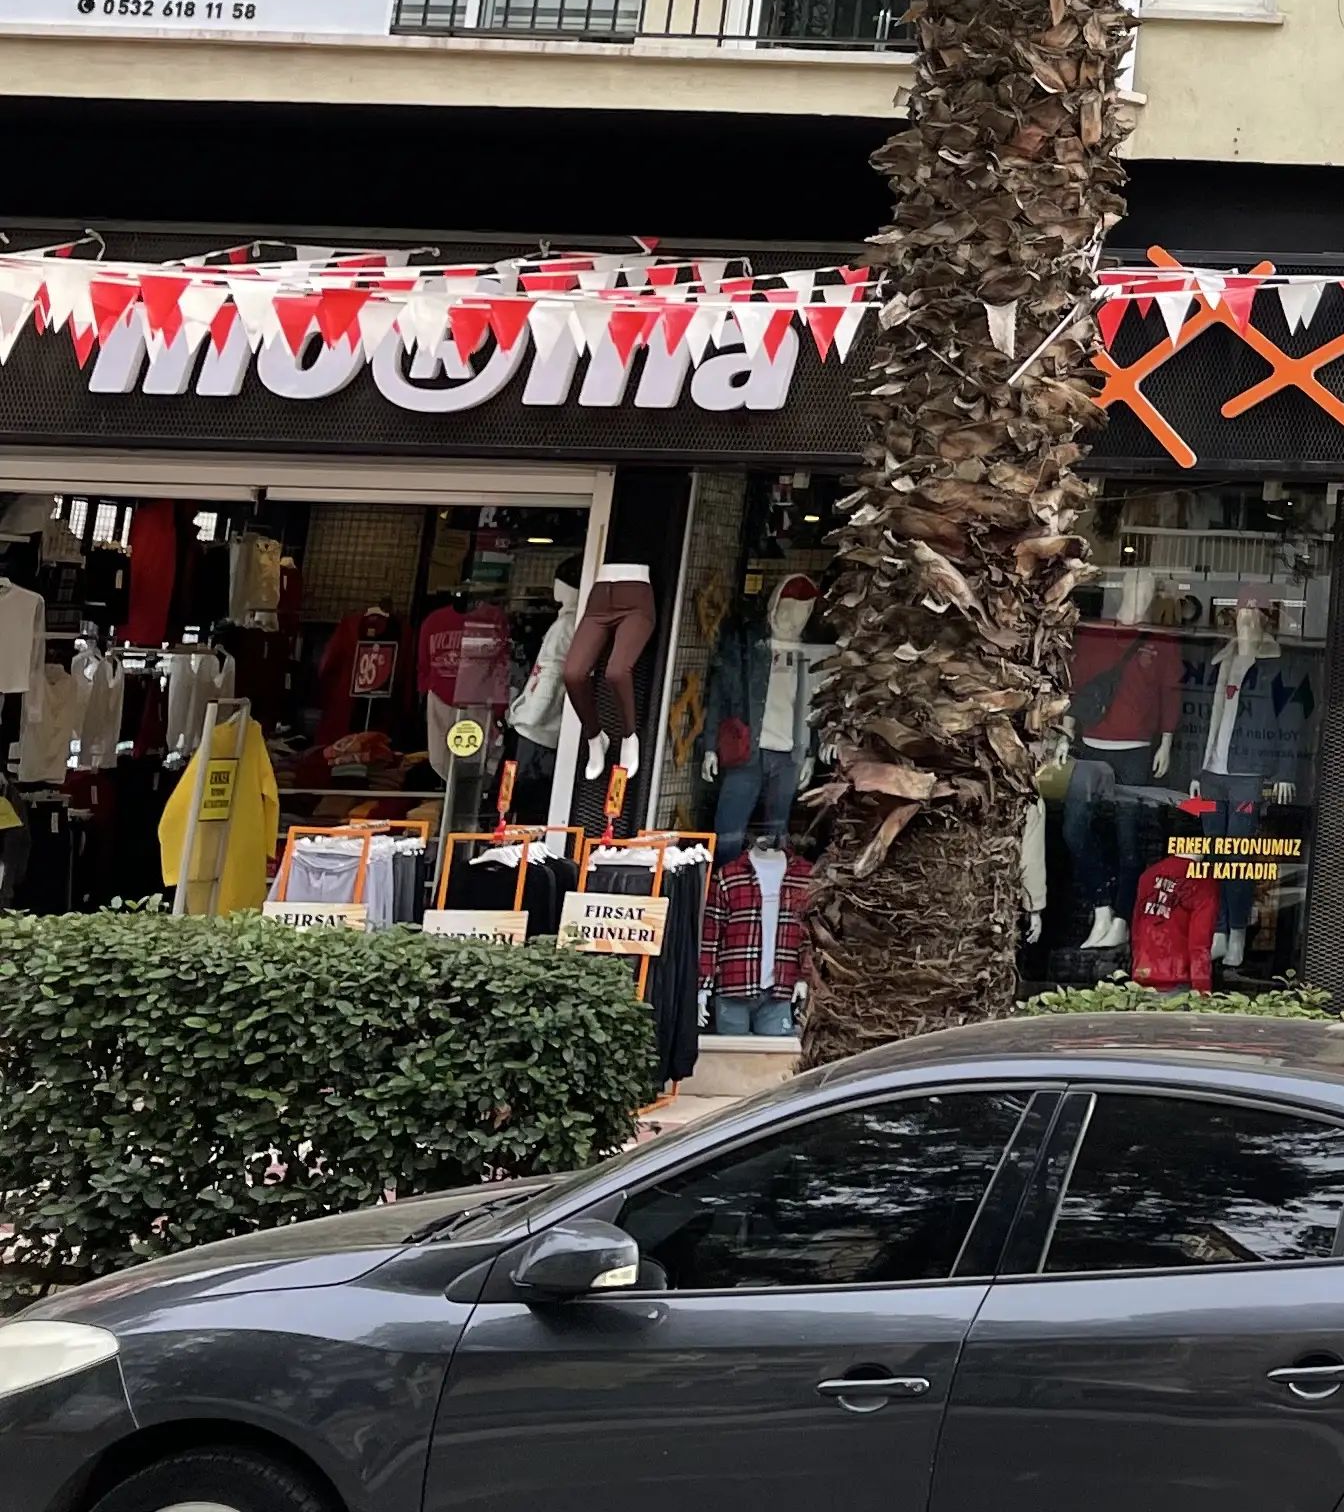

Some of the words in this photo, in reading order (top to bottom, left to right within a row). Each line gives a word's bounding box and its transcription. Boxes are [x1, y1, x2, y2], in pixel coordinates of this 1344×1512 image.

[103, 0, 154, 17] 0532
[163, 1, 195, 18] 618
[206, 2, 222, 19] 11
[232, 3, 256, 20] 58
[1167, 836, 1212, 855] ERKEK
[1214, 837, 1302, 857] REYONUMUZ
[1186, 861, 1211, 880] ALT
[1213, 862, 1279, 881] KATTADIR
[584, 904, 646, 920] FIRSAT
